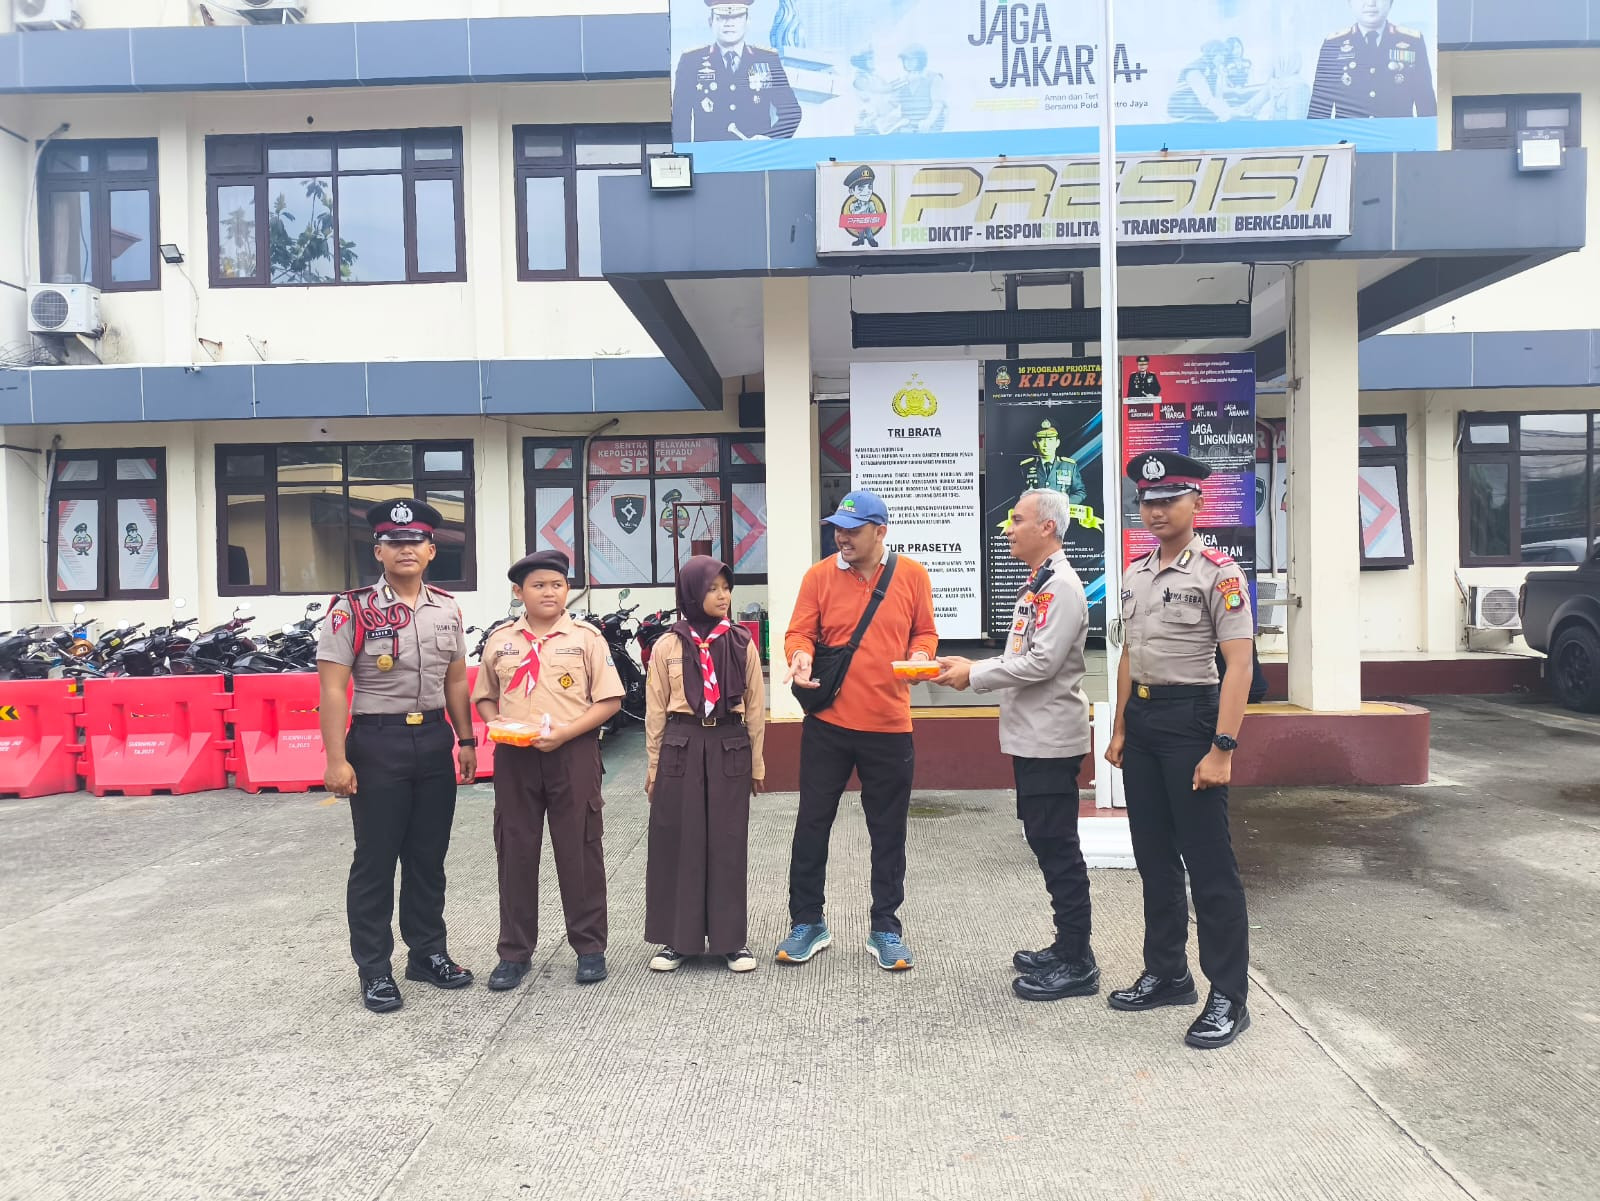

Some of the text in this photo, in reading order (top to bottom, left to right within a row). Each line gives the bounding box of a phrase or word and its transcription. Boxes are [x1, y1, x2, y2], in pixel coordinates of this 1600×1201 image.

[968, 0, 1052, 46] JAGA
[990, 43, 1147, 89] JAKARA+
[1045, 103, 1078, 111] Bersama
[1130, 100, 1149, 108] Jaya
[901, 154, 1330, 226] PRESISI
[902, 225, 973, 243] PREDIKTIF
[985, 220, 1101, 240] RESPONSIBILITA
[1122, 216, 1231, 235] TRANSPARANSI
[1234, 214, 1332, 231] BERKEADILAN
[1018, 364, 1102, 374] 16 PROGRAM PRIORITA
[888, 427, 942, 438] TRI BRATA
[1190, 422, 1213, 435] JAGA
[655, 440, 701, 448] PELAYANAN
[1199, 433, 1254, 446] LINGKUNGAN
[907, 543, 962, 552] PRASETYA
